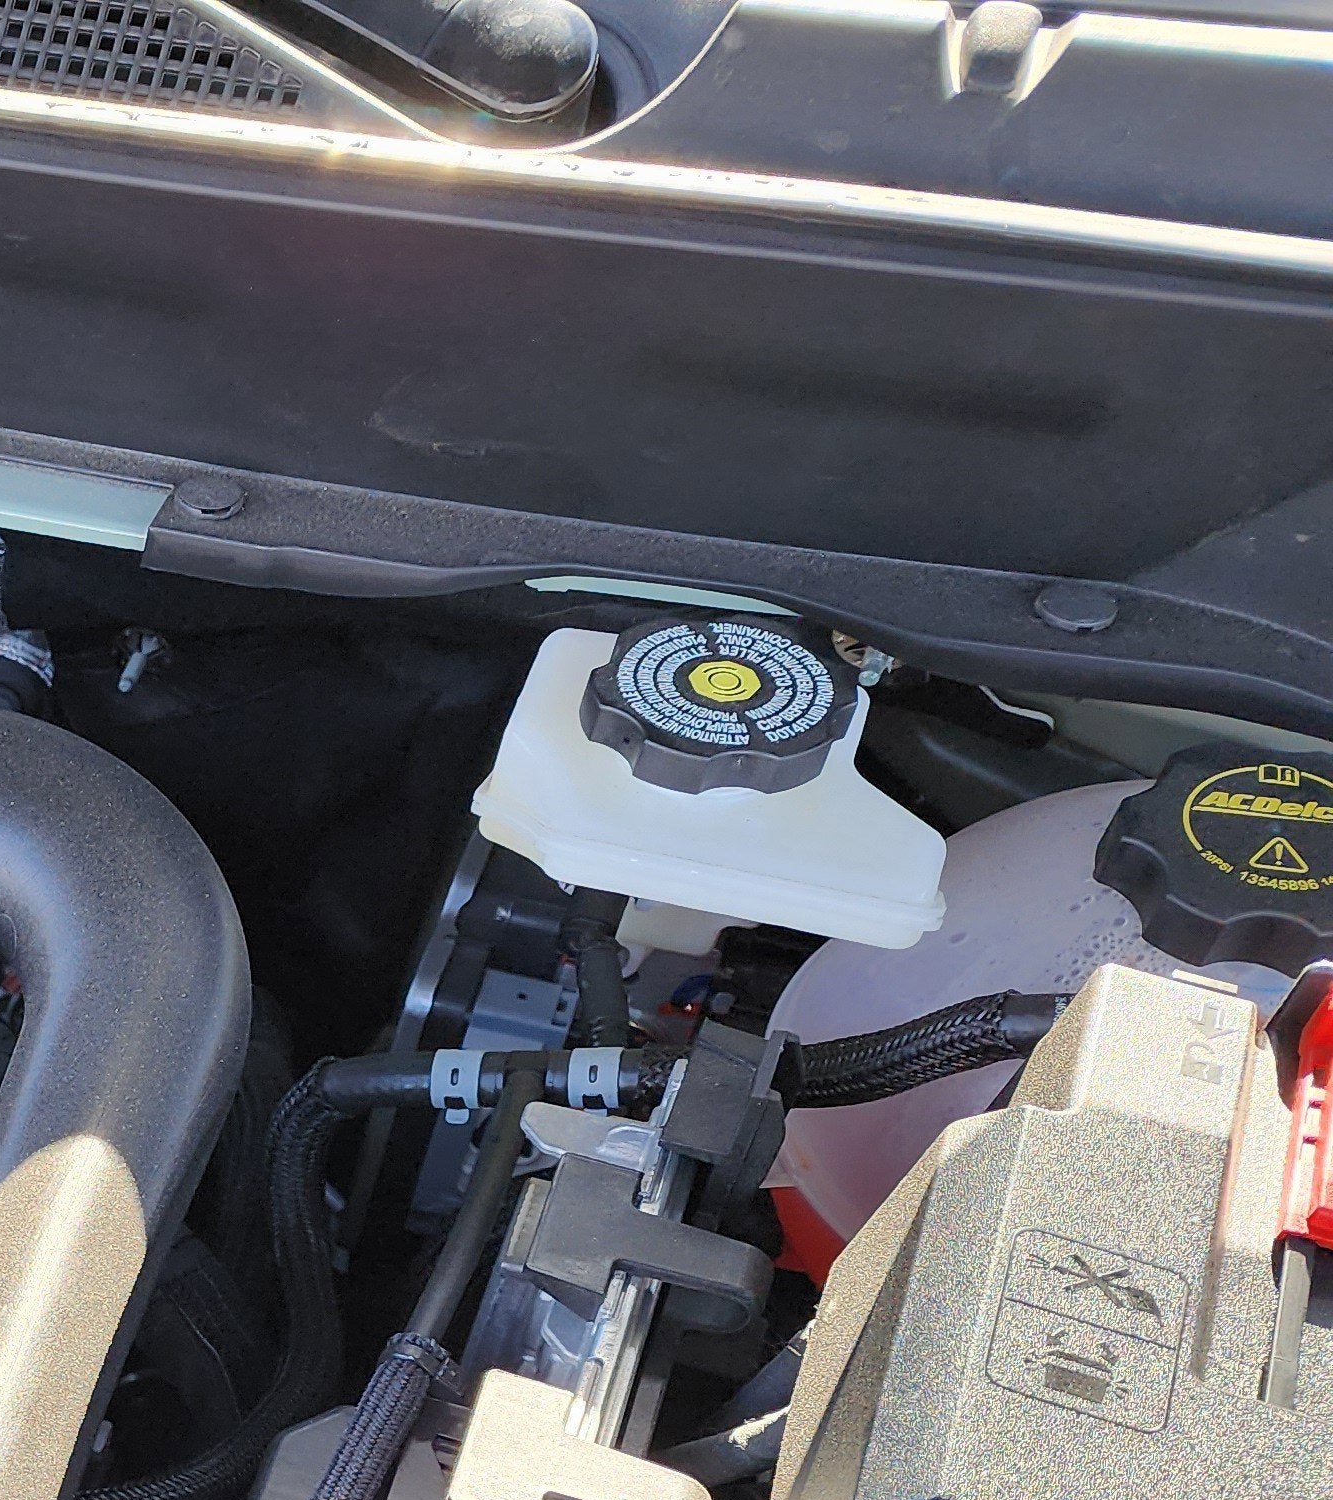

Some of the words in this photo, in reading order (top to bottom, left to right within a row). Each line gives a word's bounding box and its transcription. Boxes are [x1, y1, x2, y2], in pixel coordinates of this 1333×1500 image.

[714, 634, 752, 647] ONLY
[751, 640, 781, 656] USE
[718, 645, 766, 664] FILLER
[787, 644, 828, 676] SEALED
[760, 659, 792, 686] CLEAN
[623, 691, 644, 702] LE
[814, 681, 834, 707] FROM
[630, 700, 684, 734] NETTOYER
[653, 699, 679, 716] QUE
[669, 696, 739, 722] PROVENANT
[779, 691, 813, 721] BEFORE
[796, 705, 827, 729] FLUID
[755, 715, 783, 730] CAP
[1198, 790, 1333, 820] ACDelc
[1201, 850, 1234, 873] 20PSI
[1239, 871, 1320, 890] 13545896
